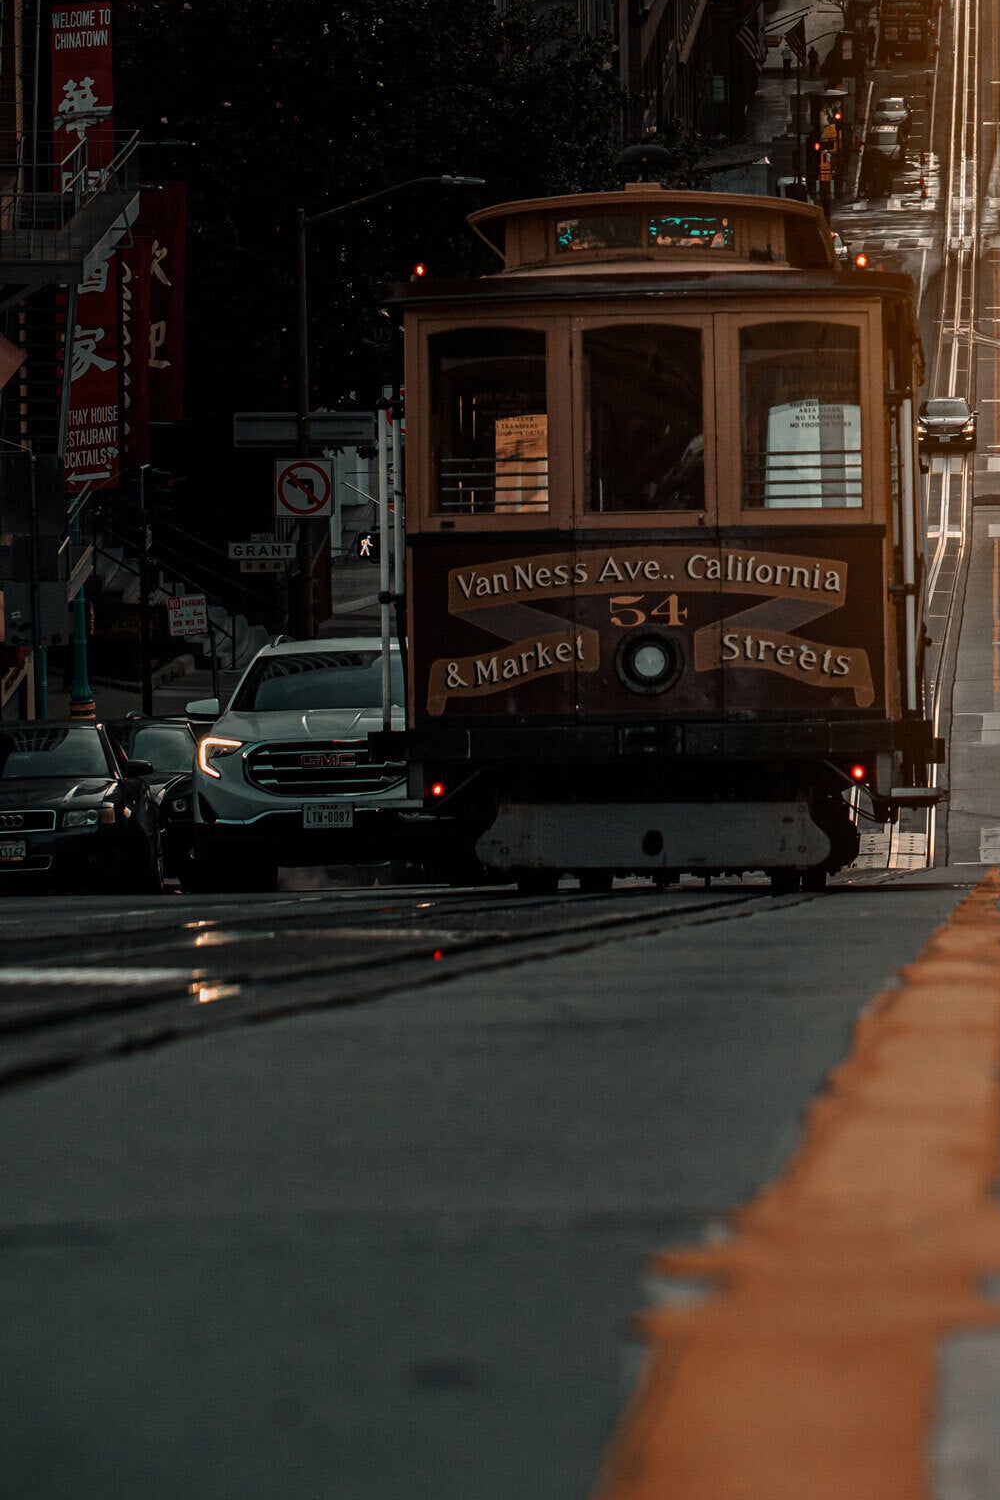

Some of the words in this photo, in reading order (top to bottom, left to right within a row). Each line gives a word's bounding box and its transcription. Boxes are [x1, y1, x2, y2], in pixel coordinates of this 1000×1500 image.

[51, 9, 95, 29] WELCOME
[99, 8, 111, 26] TO
[54, 29, 108, 50] CHINATOWN
[91, 405, 119, 424] HOUSE
[233, 545, 292, 556] GRANT
[685, 554, 841, 593] California
[168, 597, 181, 610] NO
[609, 592, 689, 628] 54
[444, 661, 469, 690] &
[473, 635, 586, 686] Market
[720, 632, 852, 677] Streets
[300, 752, 356, 768] GMC
